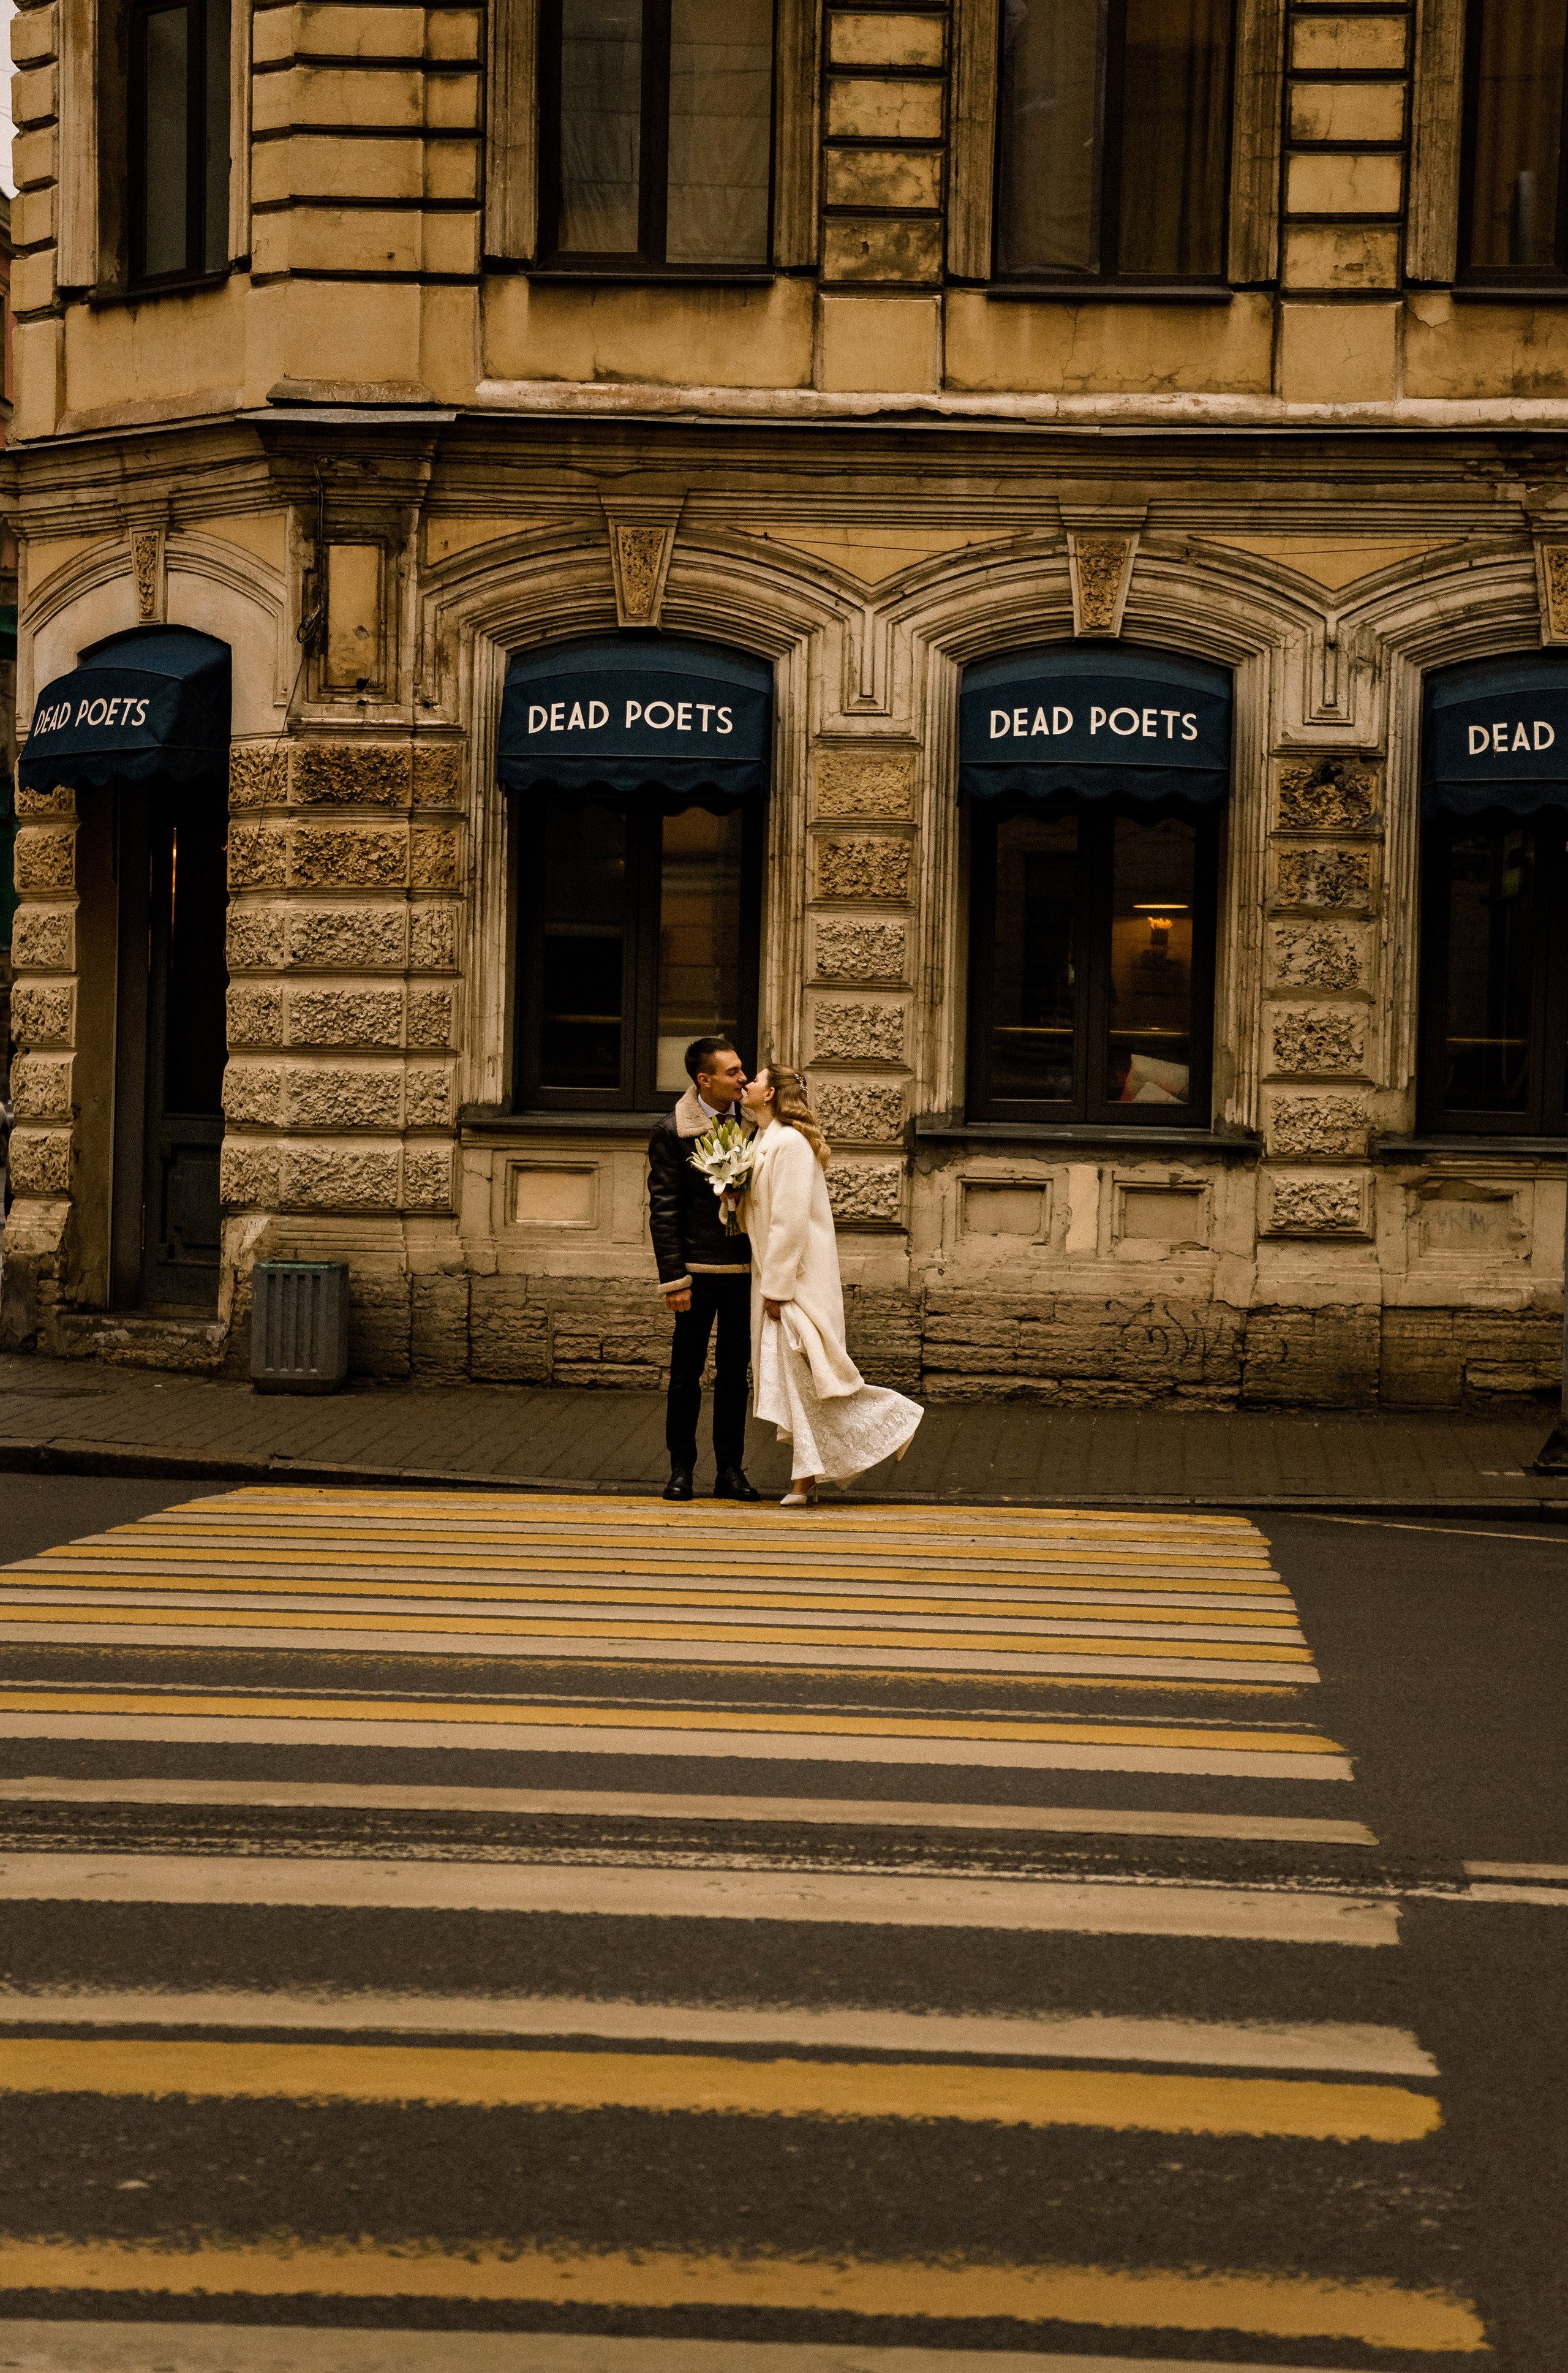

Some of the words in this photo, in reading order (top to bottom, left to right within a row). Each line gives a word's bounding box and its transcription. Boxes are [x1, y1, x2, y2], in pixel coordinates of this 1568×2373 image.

[33, 702, 71, 737] DEAD
[75, 698, 150, 727] POETS
[528, 701, 609, 734] DEAD
[625, 700, 733, 734] POETS
[990, 706, 1074, 739] DEAD
[1090, 706, 1198, 741] POETS
[1468, 721, 1555, 755] DEAD
